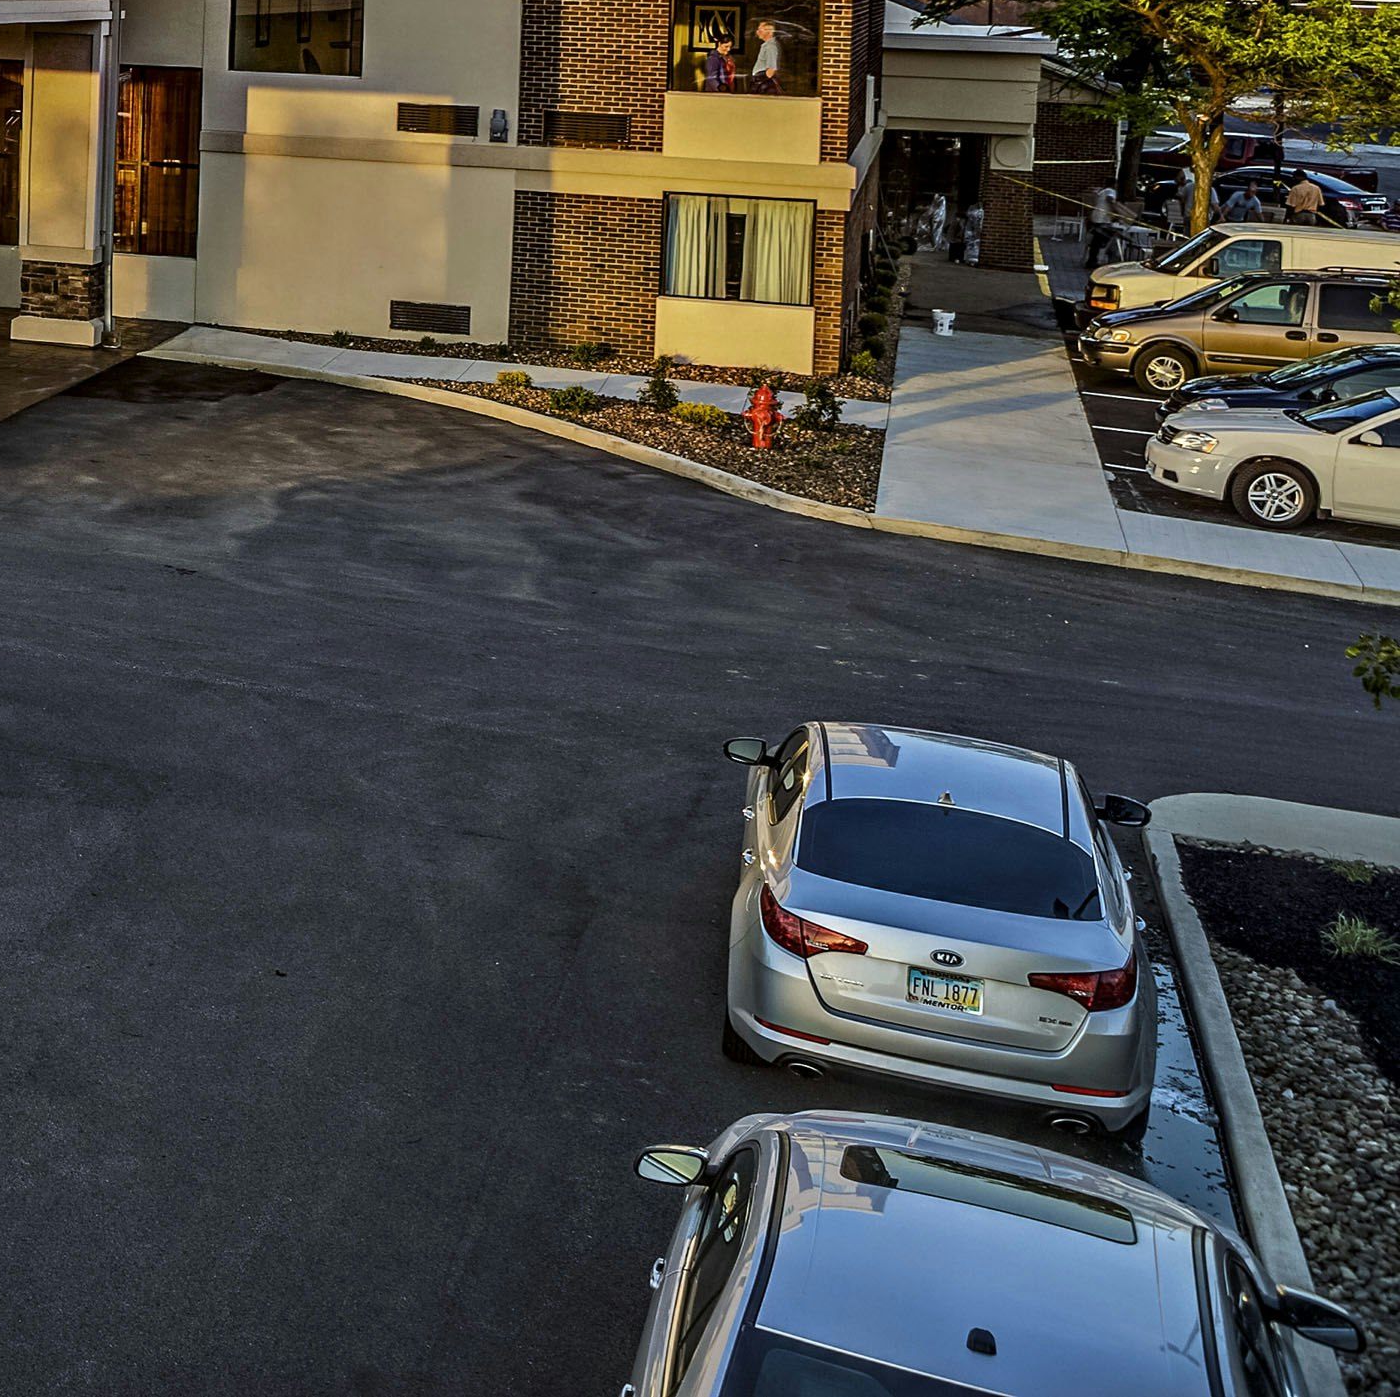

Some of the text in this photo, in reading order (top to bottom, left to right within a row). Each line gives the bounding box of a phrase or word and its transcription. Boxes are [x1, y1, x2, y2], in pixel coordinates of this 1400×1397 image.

[936, 952, 958, 964] KIA
[912, 977, 978, 1005] FNL 1877
[922, 998, 964, 1012] MENTOR
